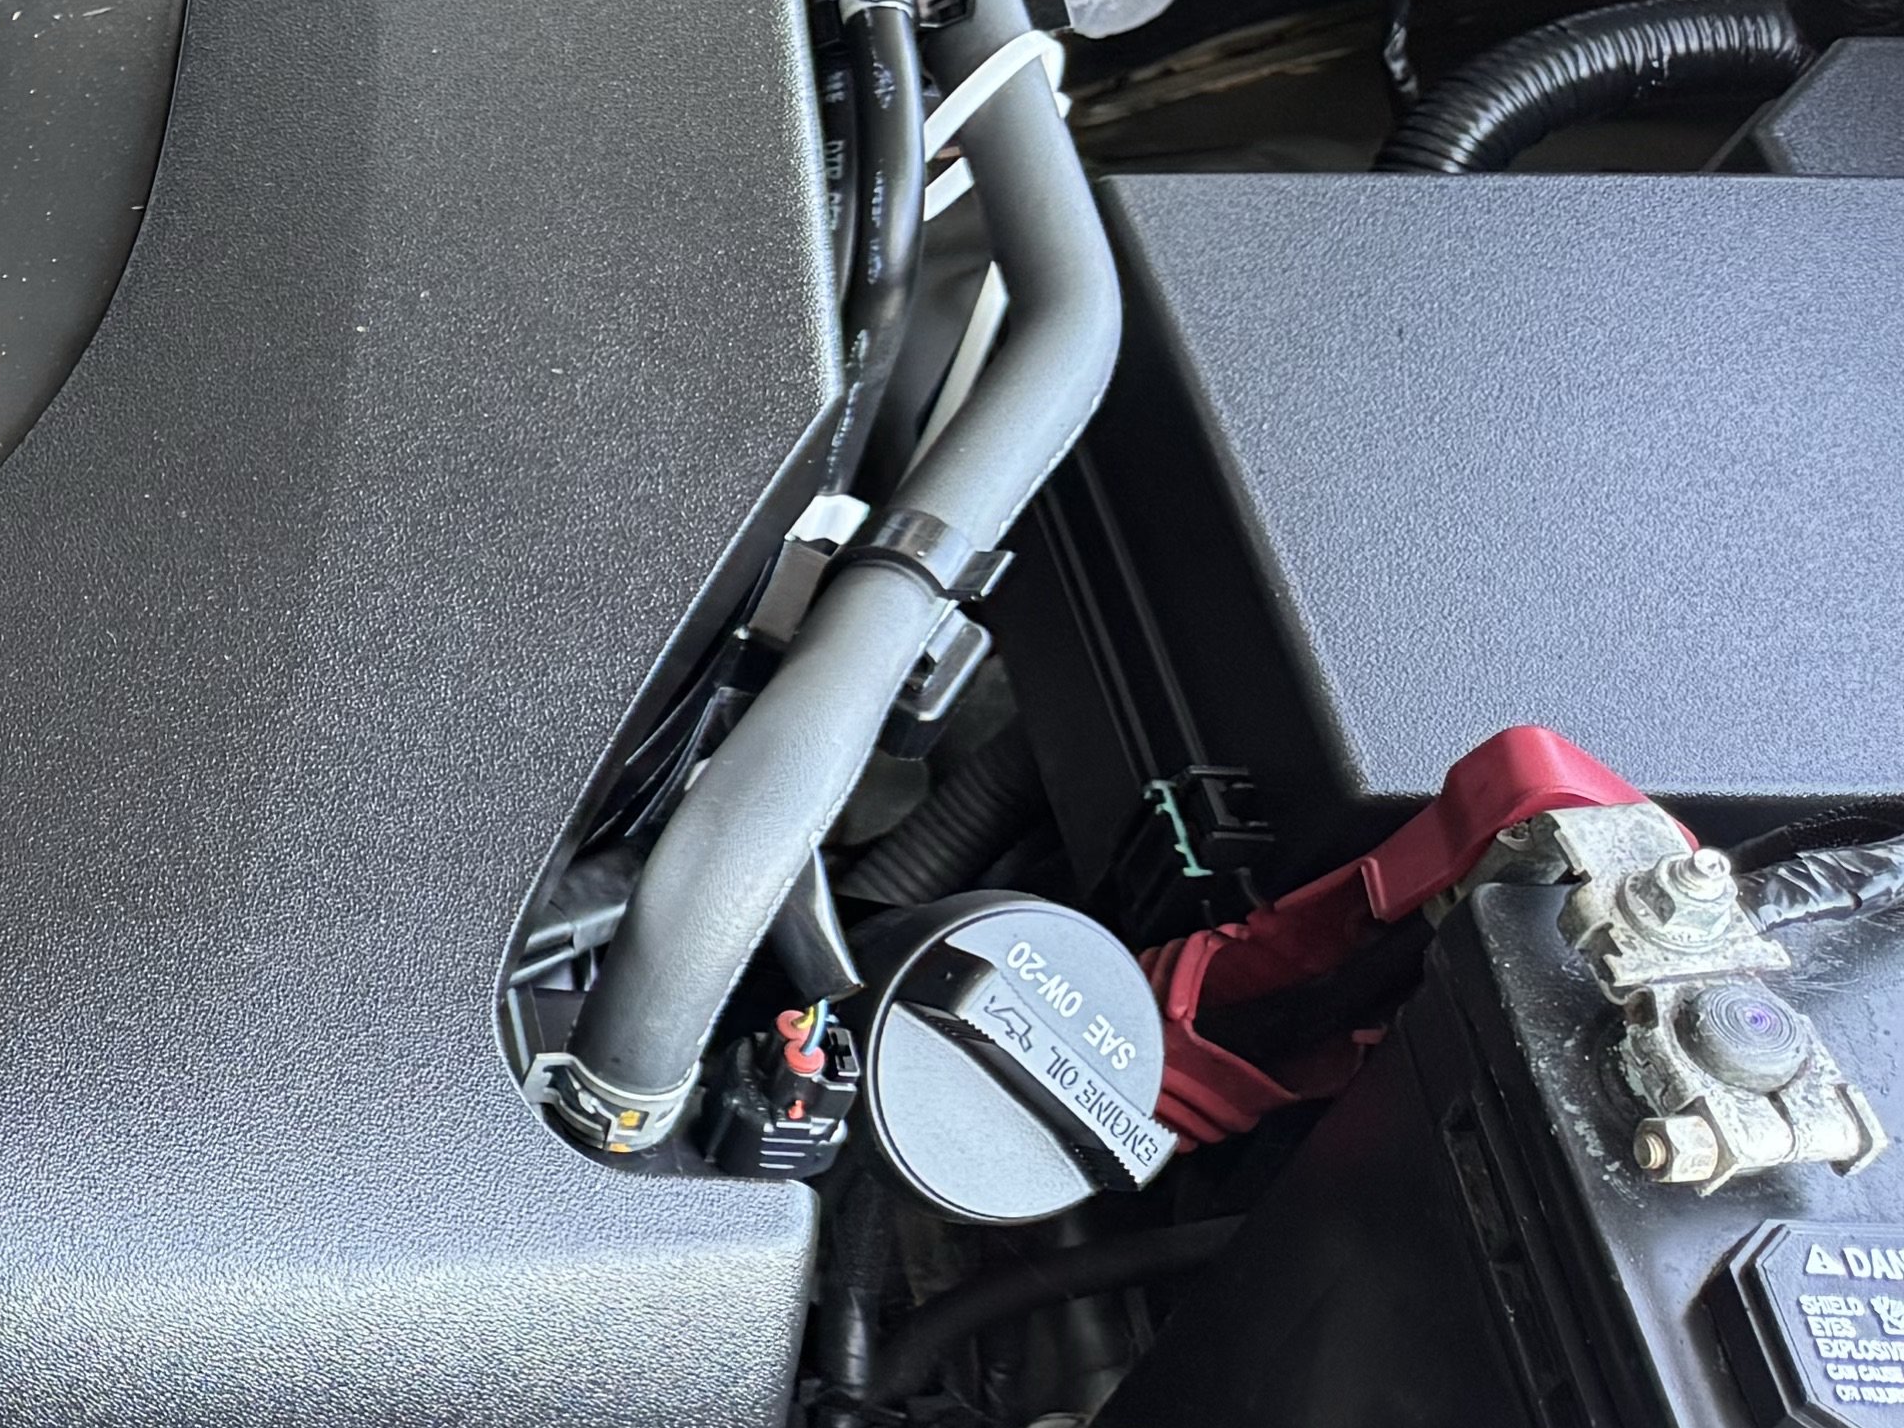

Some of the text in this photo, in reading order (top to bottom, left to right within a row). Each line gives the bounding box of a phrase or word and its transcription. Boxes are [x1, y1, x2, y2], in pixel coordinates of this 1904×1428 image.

[1005, 940, 1137, 1071] SAE 0W-20
[1045, 1044, 1160, 1168] ENGINE OIL
[1798, 1294, 1865, 1316] SHIELD
[1806, 1315, 1857, 1338] EYES
[1826, 1363, 1859, 1380] CAN
[1835, 1384, 1861, 1402] OR
